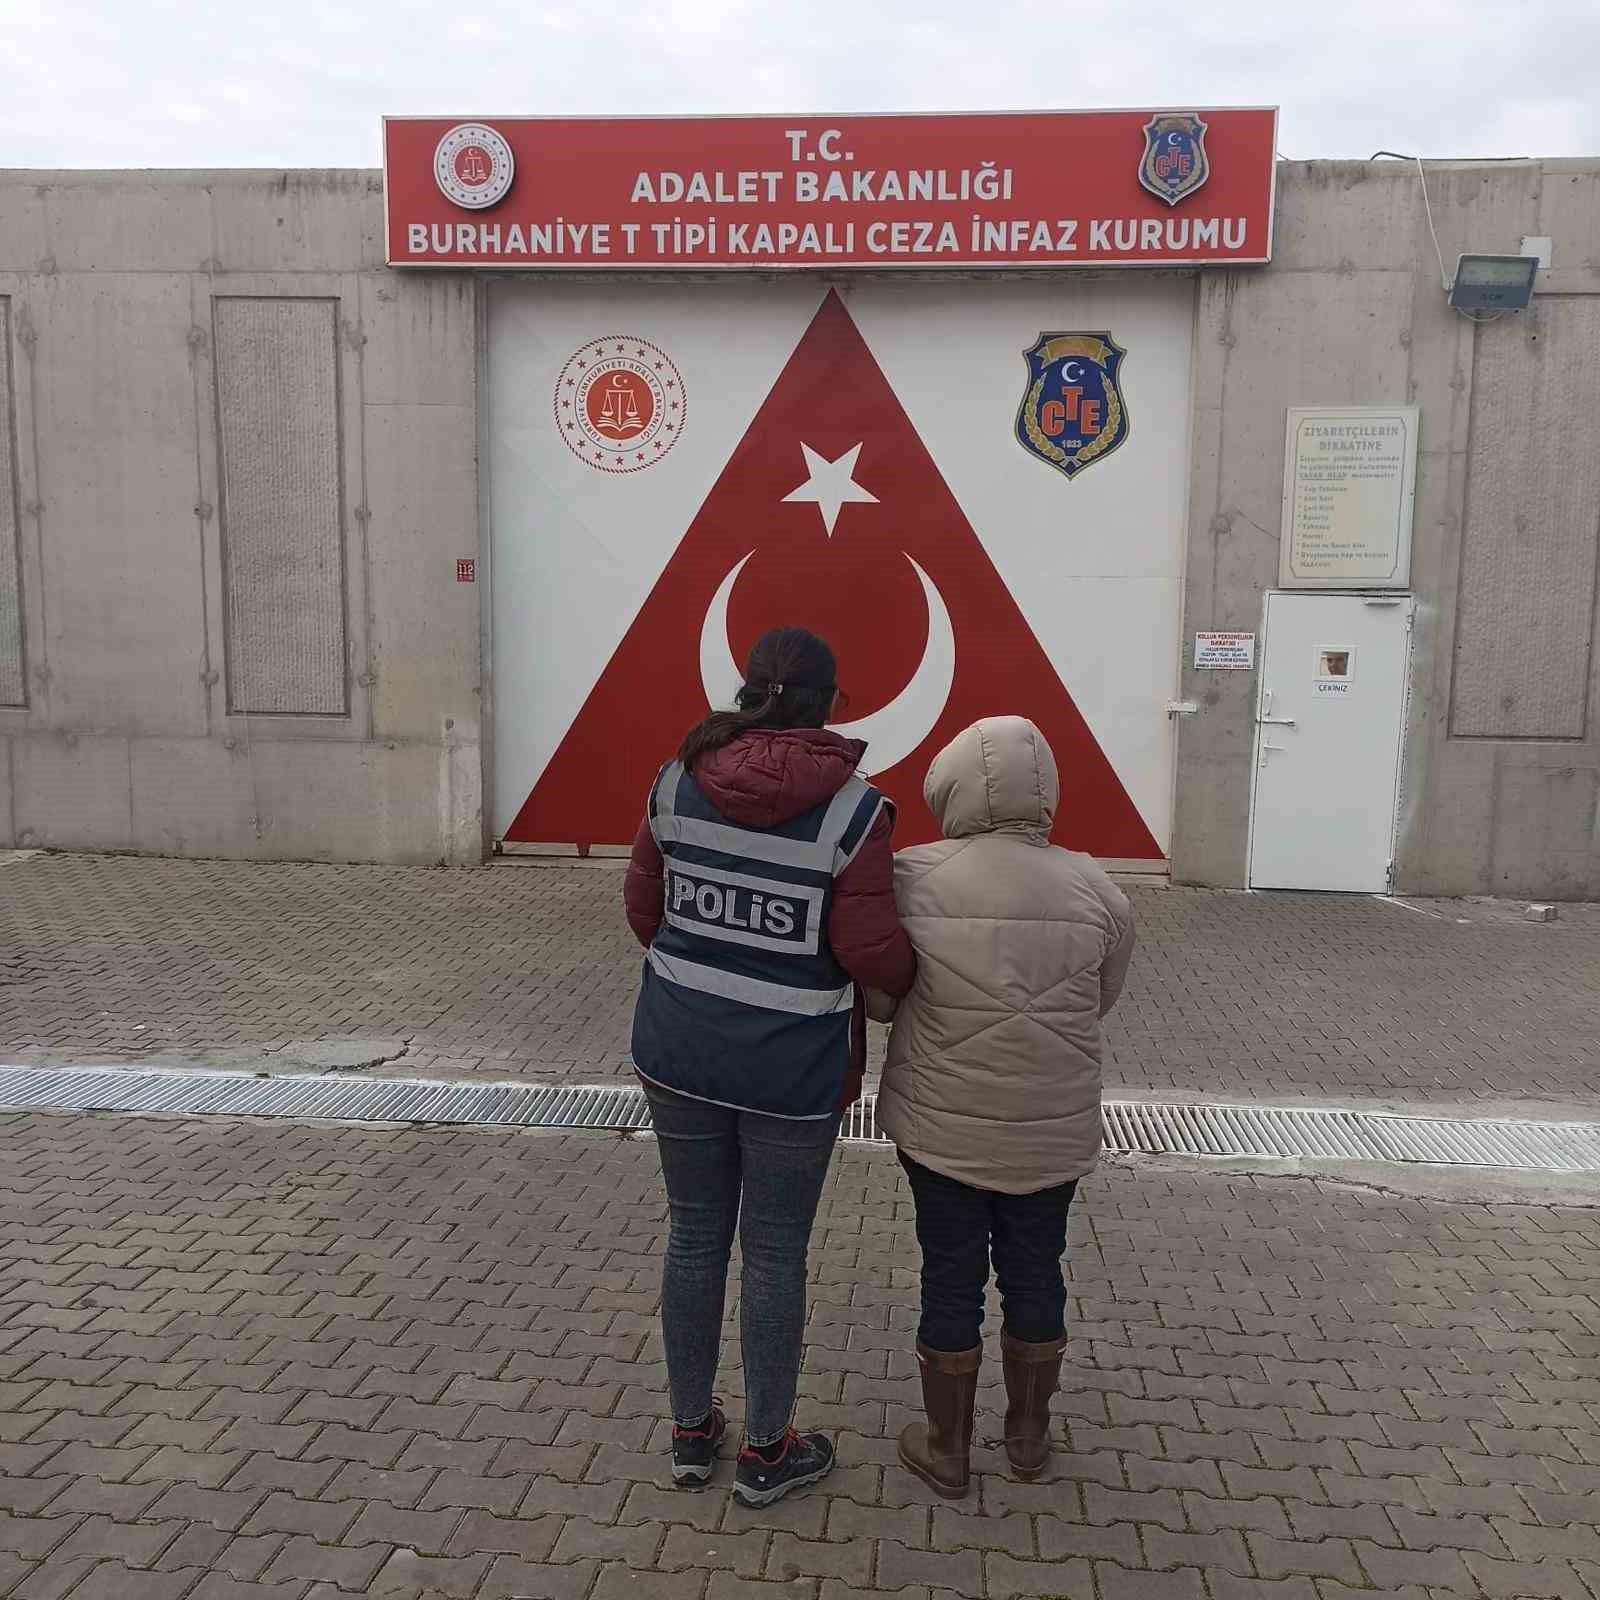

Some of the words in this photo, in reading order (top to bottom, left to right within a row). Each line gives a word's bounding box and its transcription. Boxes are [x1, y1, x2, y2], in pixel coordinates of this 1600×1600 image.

[785, 128, 854, 162] T.C.
[630, 171, 784, 204] ADALET
[796, 161, 1013, 202] BAKANLIĞI
[408, 217, 611, 255] BURHANİYE
[621, 223, 641, 255] T
[651, 216, 717, 255] TİPİ
[728, 222, 855, 255] KAPALI
[866, 222, 961, 253] CEZA
[971, 214, 1077, 252] İNFAZ
[1088, 217, 1247, 251] KURUMU
[458, 564, 474, 575] 112
